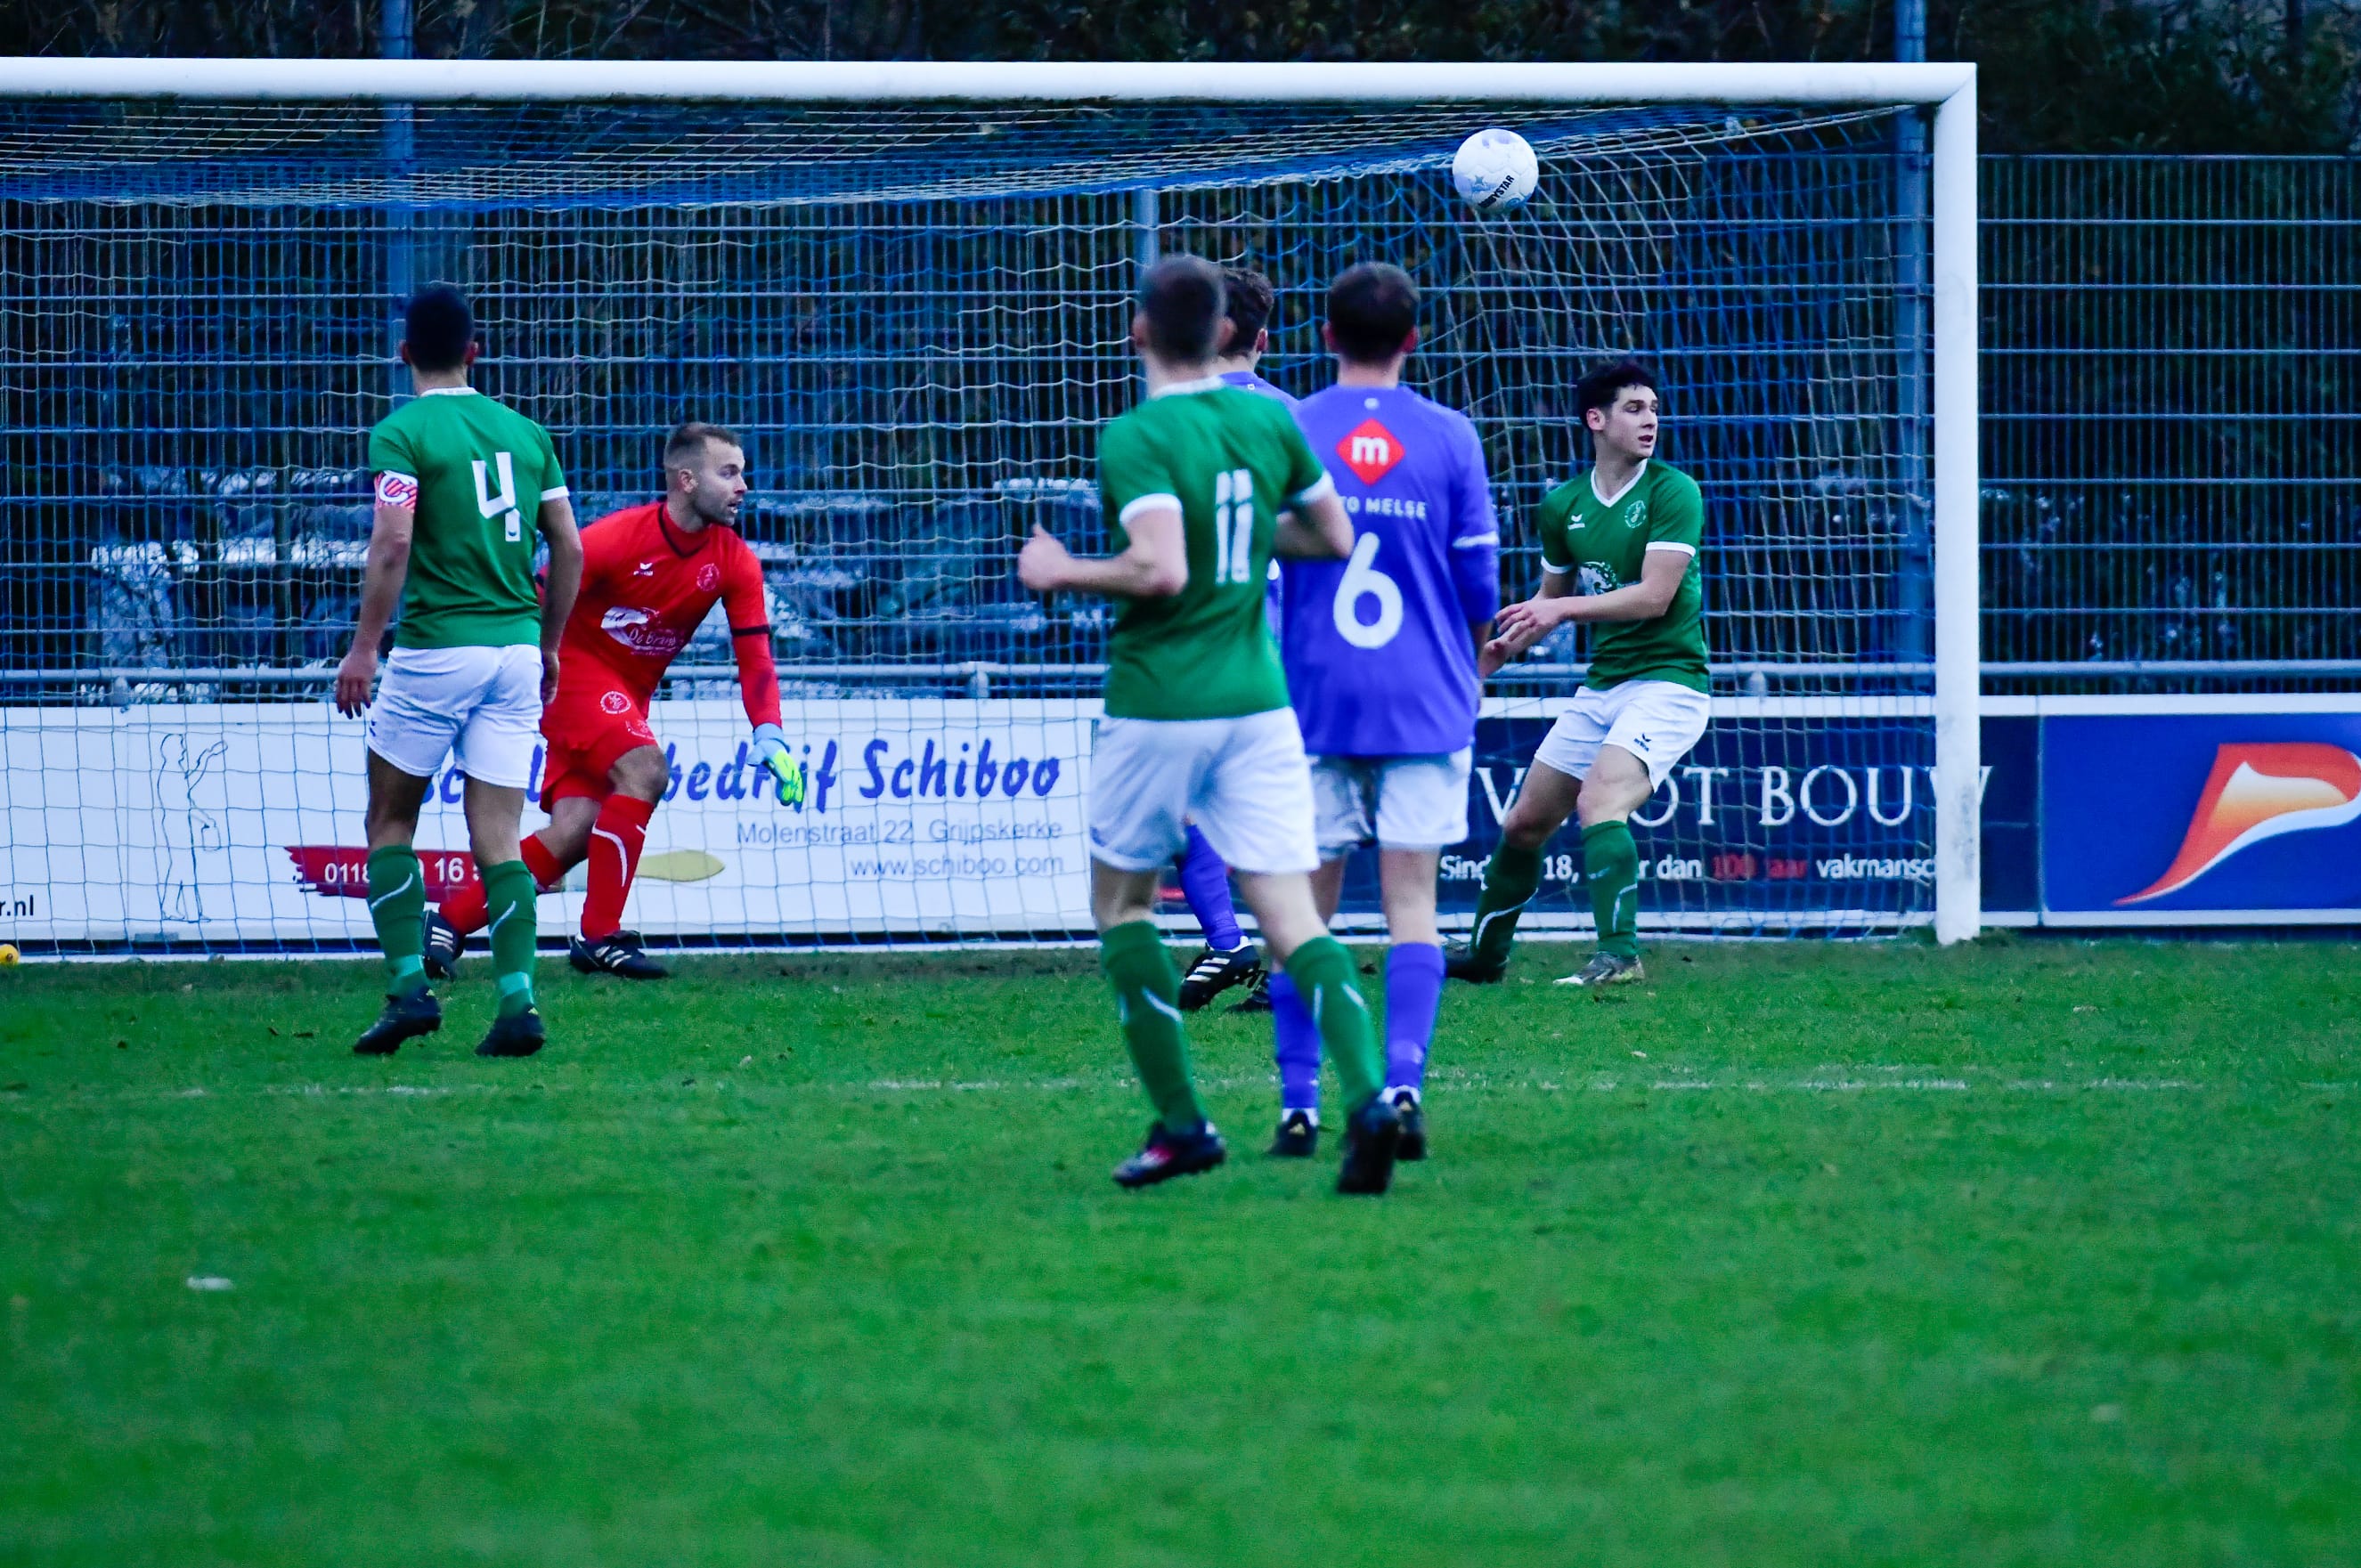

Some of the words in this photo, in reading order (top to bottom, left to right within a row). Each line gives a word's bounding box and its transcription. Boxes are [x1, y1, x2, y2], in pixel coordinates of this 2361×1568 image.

[471, 451, 521, 542] 4
[1364, 497, 1427, 520] MELSE
[1216, 468, 1254, 584] 11
[1333, 532, 1404, 650] 6
[859, 738, 1060, 799] Schiboo
[737, 820, 877, 844] Molenstraat
[883, 820, 913, 843] 22
[928, 818, 1063, 845] Grijpskerke
[435, 857, 465, 882] 16
[851, 855, 1064, 876] www.schiboo.com
[1543, 855, 1580, 884] 18,
[1656, 853, 1702, 881] dan
[1712, 852, 1755, 880] 100
[1816, 853, 1936, 881] vakmansc
